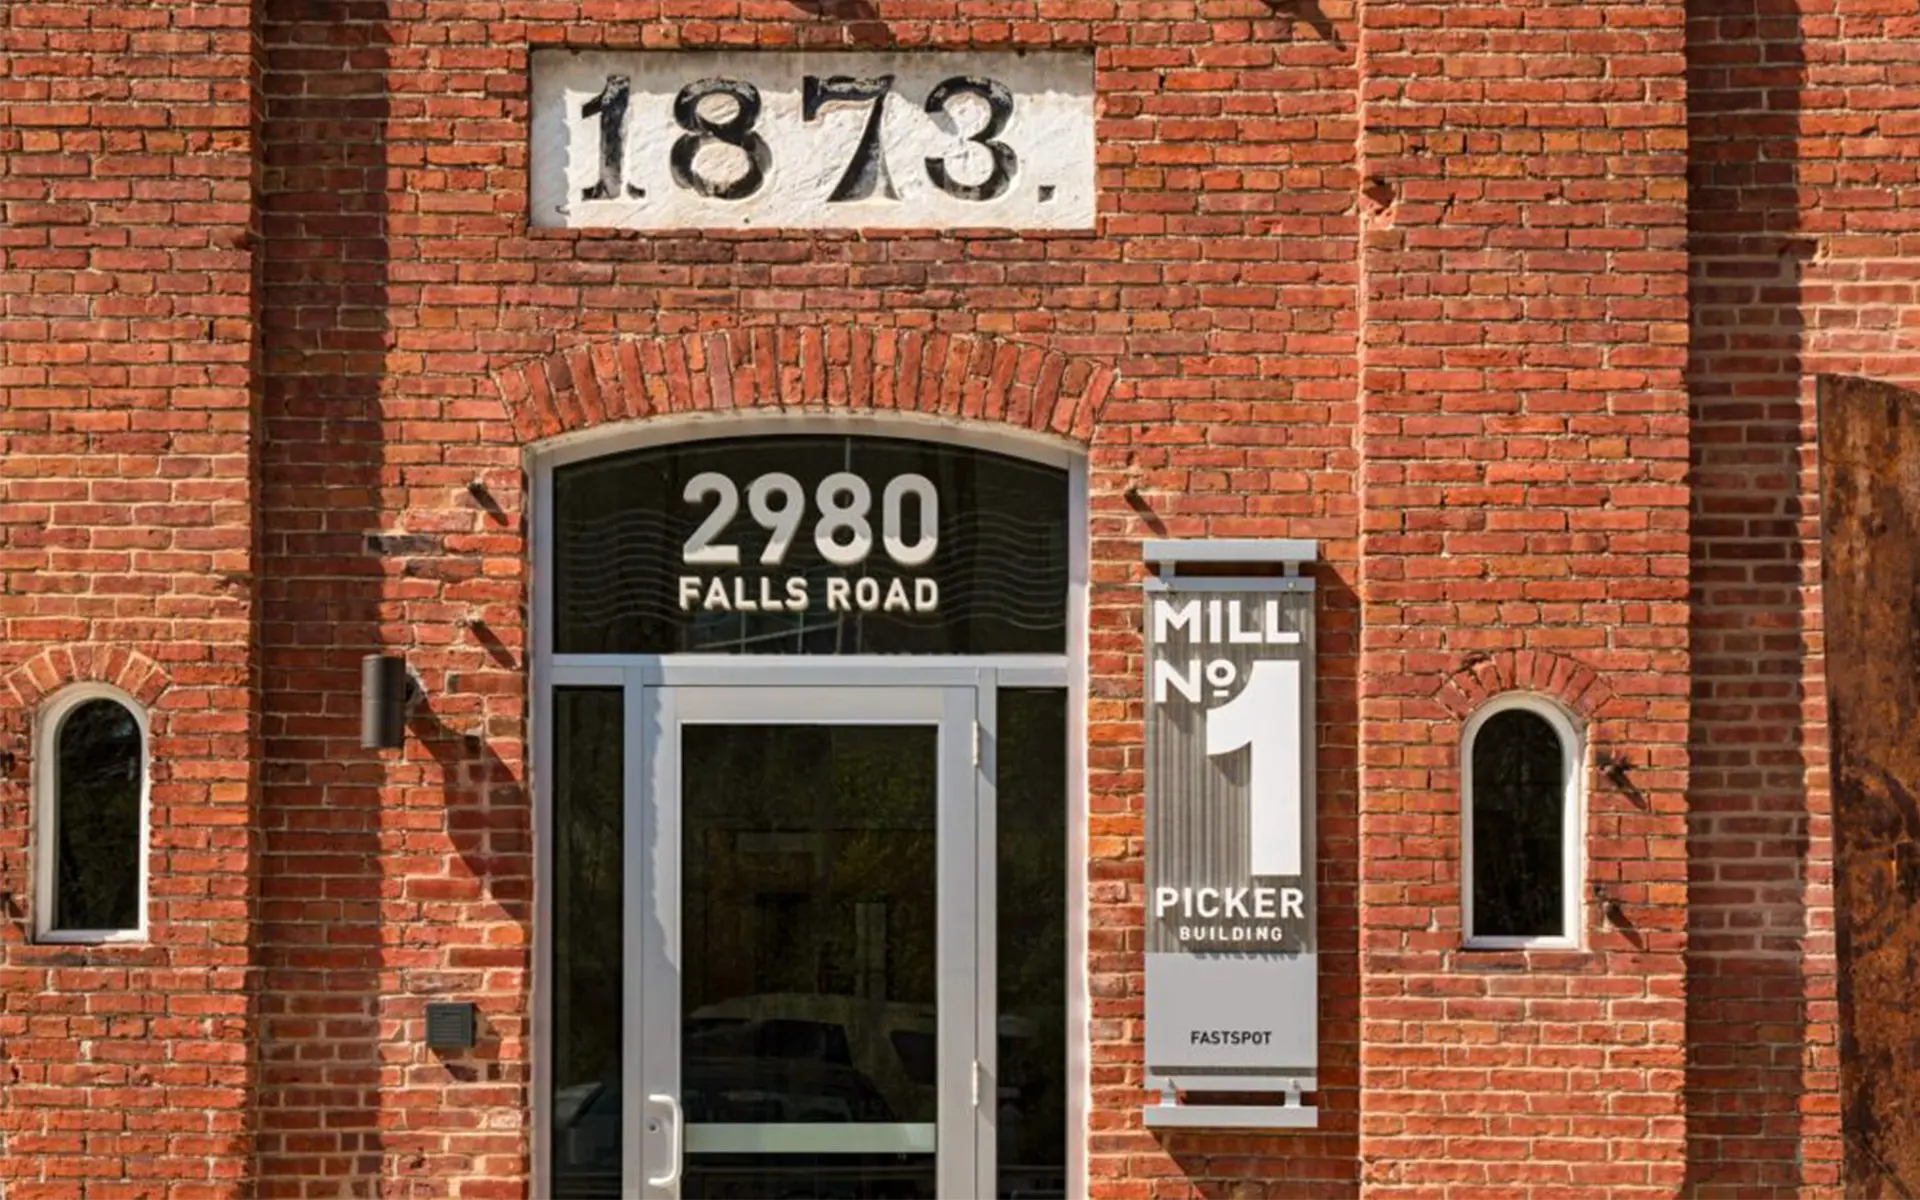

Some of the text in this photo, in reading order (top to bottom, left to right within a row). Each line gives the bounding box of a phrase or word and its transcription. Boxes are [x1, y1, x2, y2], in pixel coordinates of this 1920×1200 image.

[581, 74, 1056, 202] 1873.
[682, 472, 939, 565] 2980
[678, 576, 939, 612] FALLS ROAD
[1154, 600, 1301, 644] MILL
[1206, 660, 1301, 876] 1
[1155, 887, 1305, 919] PICKER
[1179, 926, 1283, 942] BUILDING
[1190, 1030, 1272, 1045] FASTSPOT
